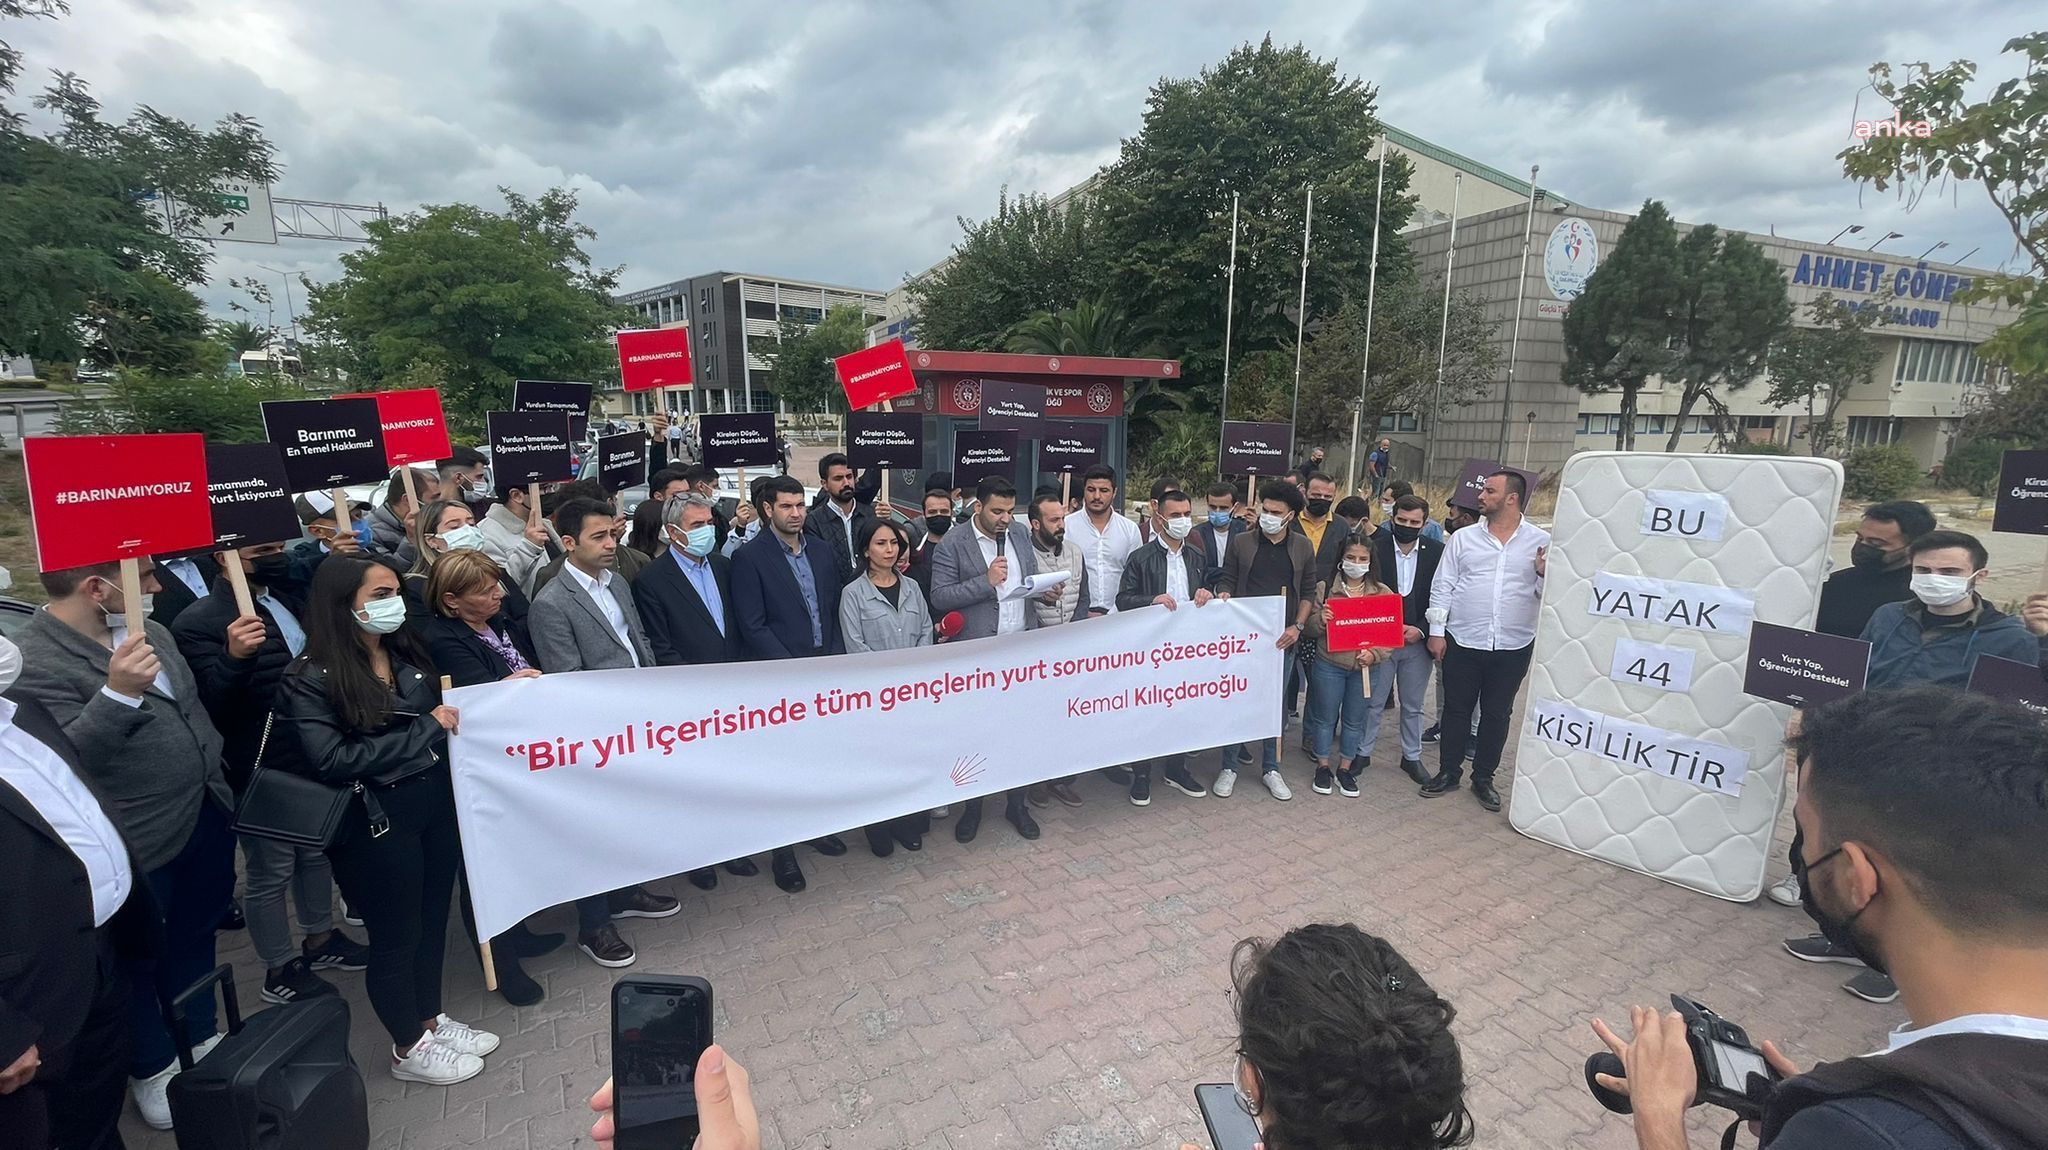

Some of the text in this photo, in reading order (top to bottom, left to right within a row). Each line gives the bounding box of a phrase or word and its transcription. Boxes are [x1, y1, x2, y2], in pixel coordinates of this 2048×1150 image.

[1792, 253, 1971, 302] AHMET CÖME
[628, 351, 683, 363] #BARINAMIYORUZ
[850, 362, 902, 383] #BARINAMIYORUZ
[1064, 388, 1083, 396] SPOR
[987, 406, 1013, 416] Öğrenciyi
[381, 418, 435, 431] NAMIYORUZ
[297, 428, 356, 443] Barınma
[524, 434, 559, 442] Tamamında,
[740, 430, 760, 438] Düşür,
[886, 430, 907, 438] Düşür,
[287, 439, 373, 457] En Temel Hakkımız!
[495, 444, 527, 453] Öğrenciye
[540, 442, 567, 451] İstiyoruz!
[710, 436, 769, 447] Öğrenciyi Destekle!
[854, 437, 885, 446] Öğrenciyi
[1046, 444, 1071, 454] Öğrenciyi
[1228, 446, 1255, 455] Öğrenciyi
[609, 450, 635, 462] Barınma
[961, 456, 987, 465] Öğrenciyi
[208, 478, 268, 492] amamında,
[56, 481, 192, 505] #BARINAMIYORUZ
[209, 487, 285, 505] Yurt İstiyoruz!
[1650, 506, 1706, 536] BU
[1593, 587, 1720, 629] YATAK
[1335, 615, 1395, 626] #BARINAMIYORUZ
[1781, 653, 1824, 671] Yurt Yap,
[1626, 658, 1671, 687] 44
[1759, 657, 1849, 687] Öğrenciyi Destekle!
[1067, 674, 1248, 718] Kemal Kılıçdaroğlu
[592, 724, 635, 768] yıl
[645, 698, 807, 756] içerisinde
[813, 688, 872, 717] tüm
[878, 668, 996, 712] gençlerin
[1001, 659, 1047, 691] yurt
[1052, 647, 1146, 679] sorununu
